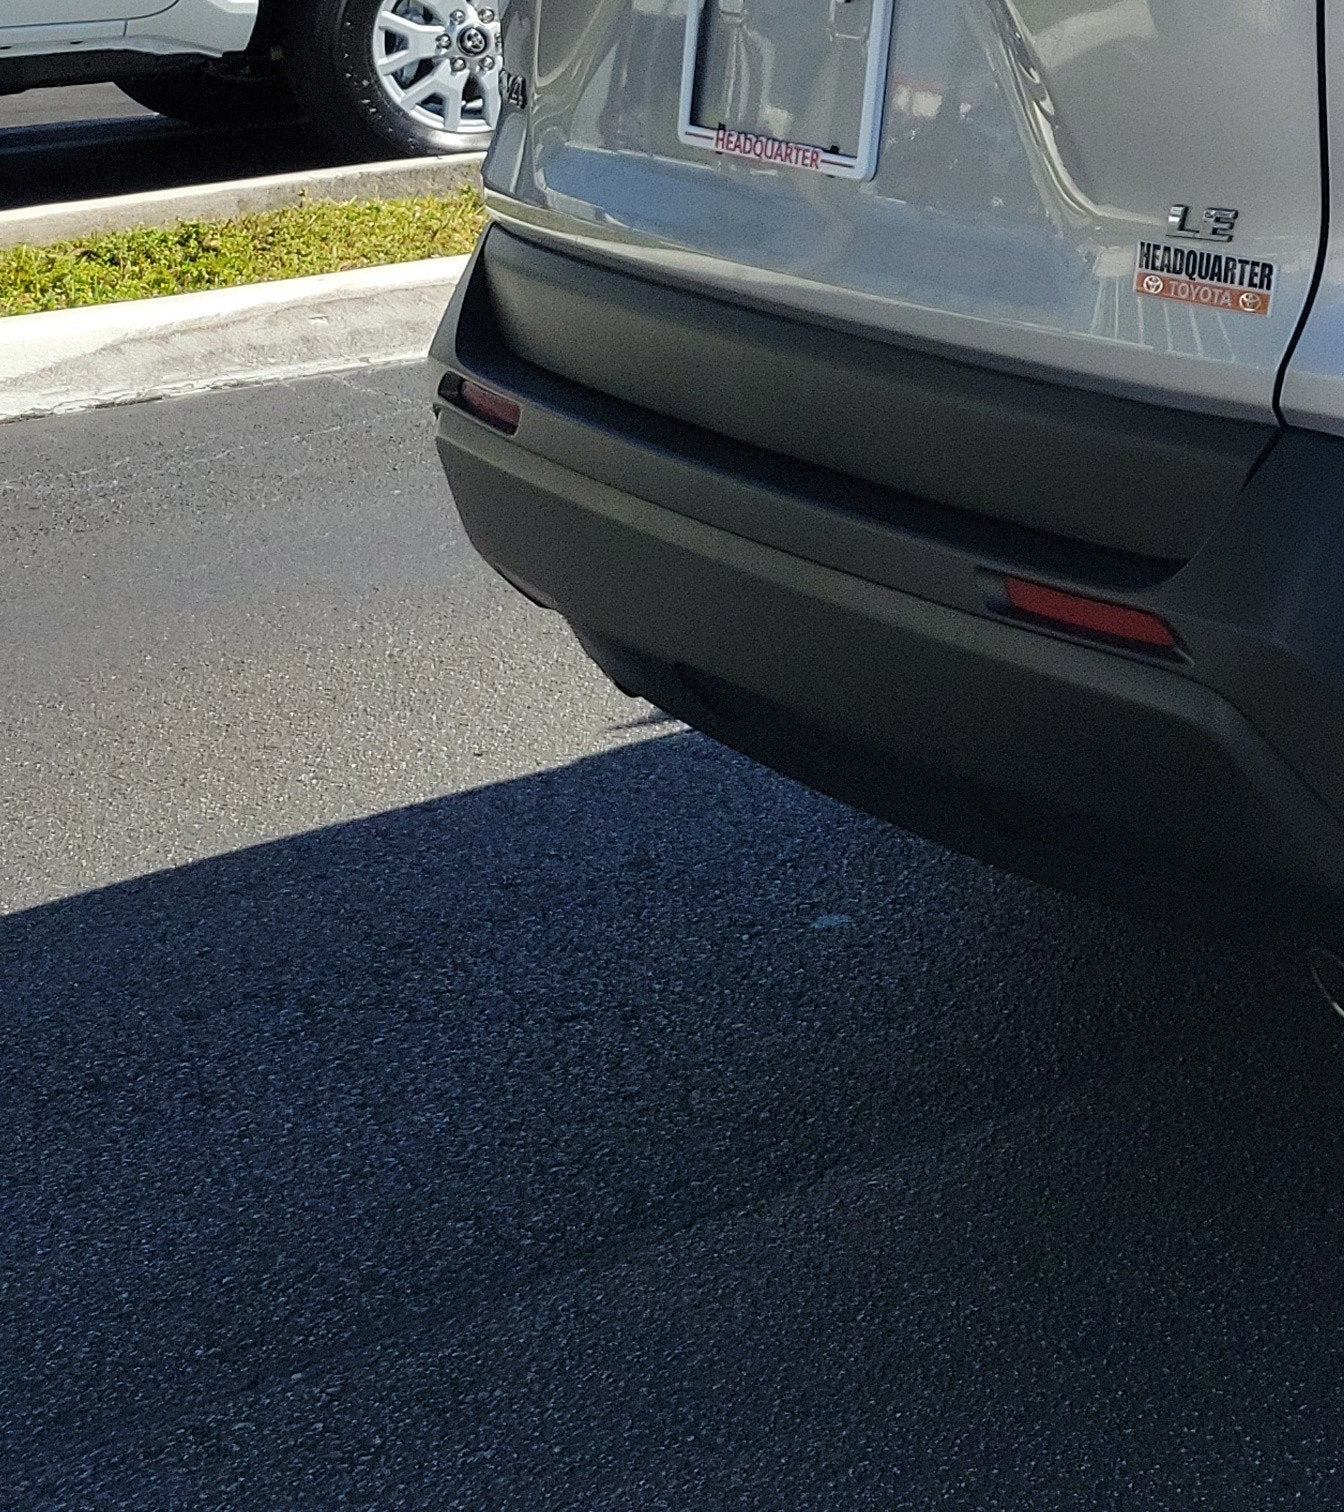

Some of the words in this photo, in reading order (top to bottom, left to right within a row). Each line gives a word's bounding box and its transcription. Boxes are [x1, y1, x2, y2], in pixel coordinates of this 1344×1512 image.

[715, 128, 821, 170] HEADQUARTER
[1166, 203, 1239, 243] LE
[1138, 241, 1274, 291] HEADQUARTER
[1168, 279, 1233, 308] TOYOTA
